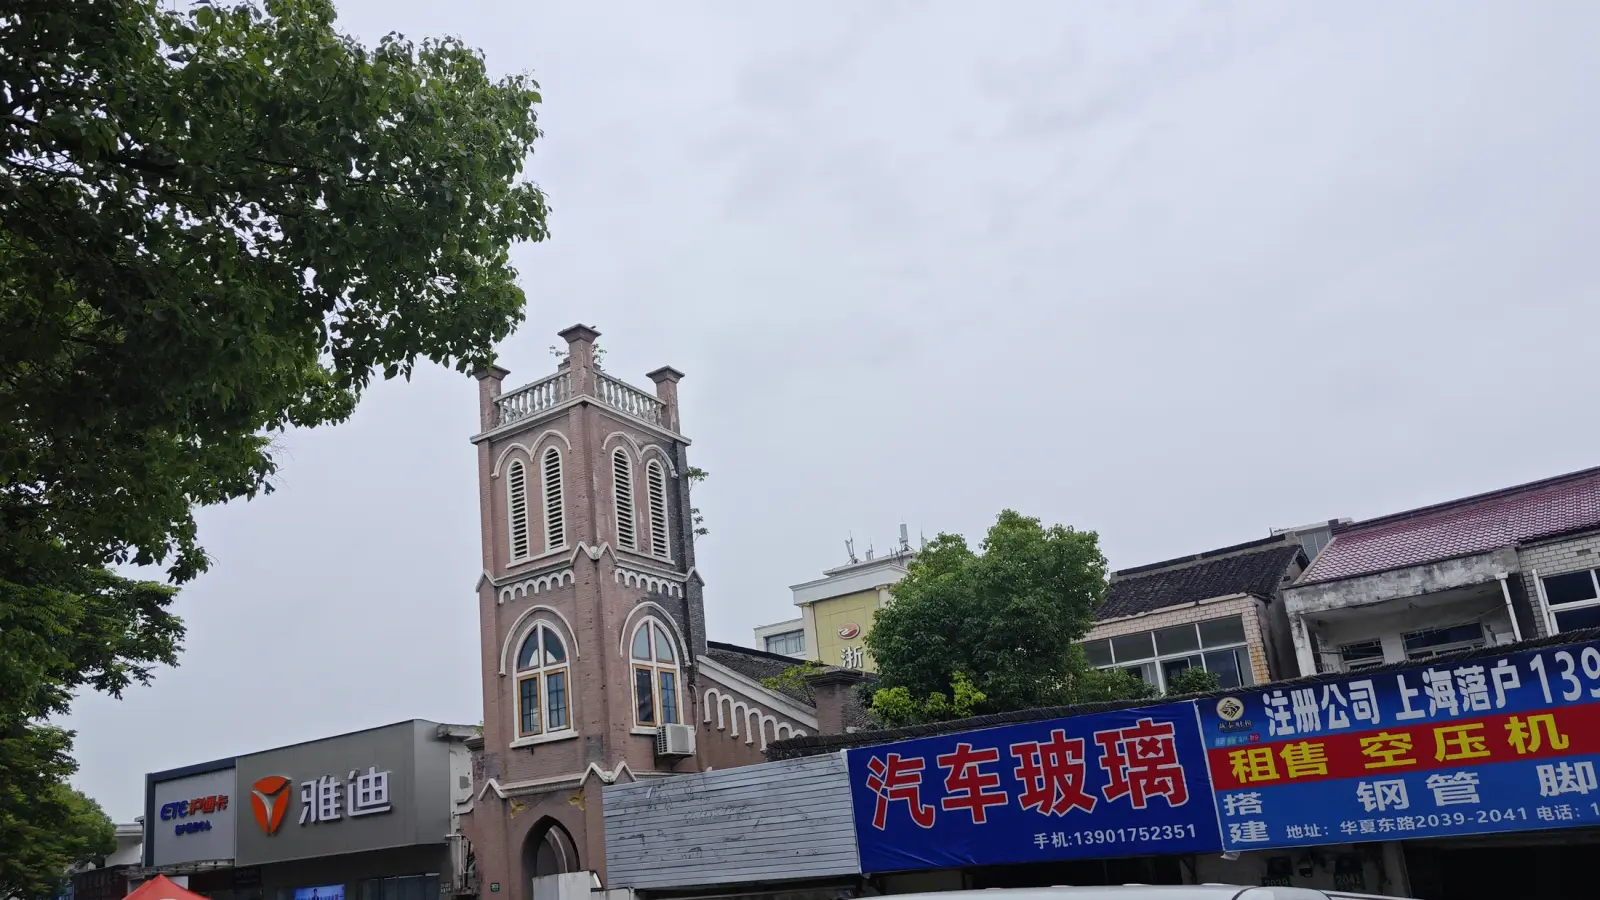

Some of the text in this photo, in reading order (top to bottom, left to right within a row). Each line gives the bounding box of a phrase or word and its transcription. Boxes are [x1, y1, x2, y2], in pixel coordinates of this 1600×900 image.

[840, 646, 863, 669] 浙
[1262, 646, 1600, 737] 注册公司 上海落户 139
[865, 717, 1189, 831] 汽车玻璃
[1228, 713, 1570, 784] 租售 空压机
[299, 766, 393, 825] 雅迪
[1355, 761, 1598, 812] 钢管 脚
